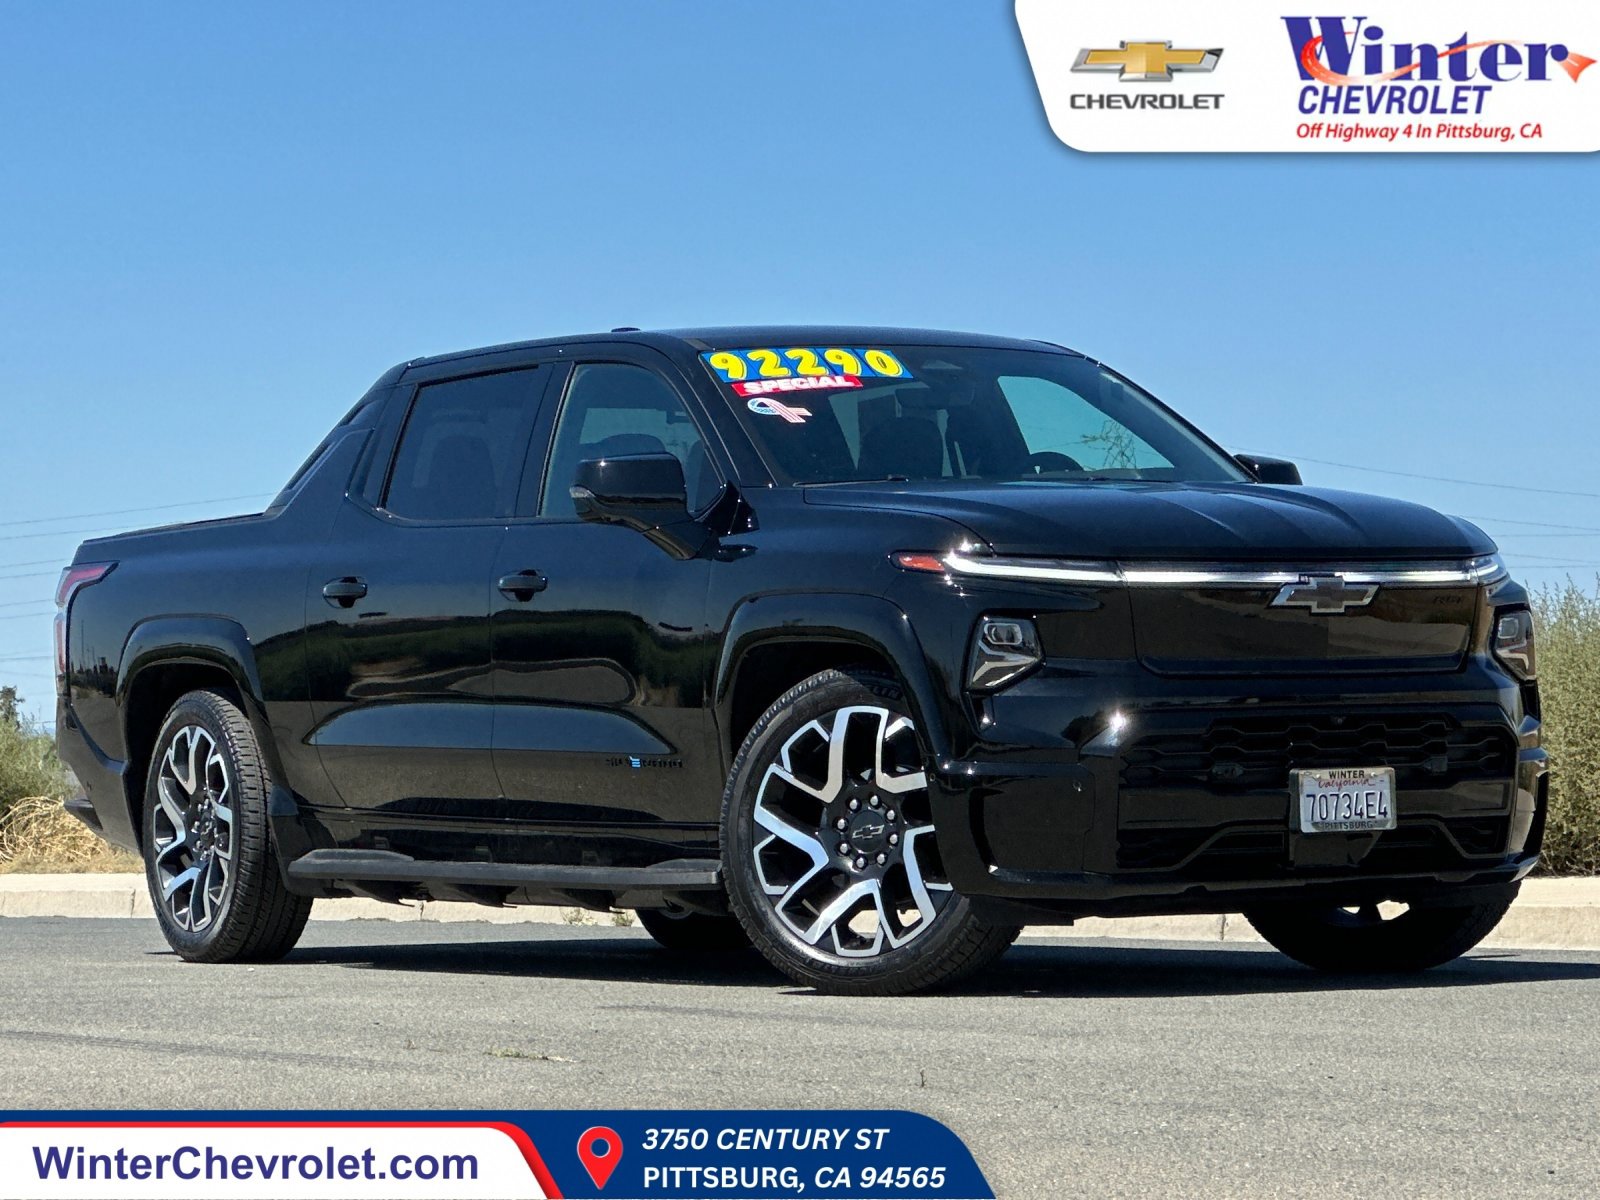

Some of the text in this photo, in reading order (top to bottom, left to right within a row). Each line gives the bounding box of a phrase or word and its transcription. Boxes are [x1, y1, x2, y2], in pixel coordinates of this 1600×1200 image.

[709, 349, 903, 380] 92290
[743, 375, 854, 396] SPECIAL
[1328, 770, 1365, 779] WINTER
[1306, 791, 1387, 821] 70734E4
